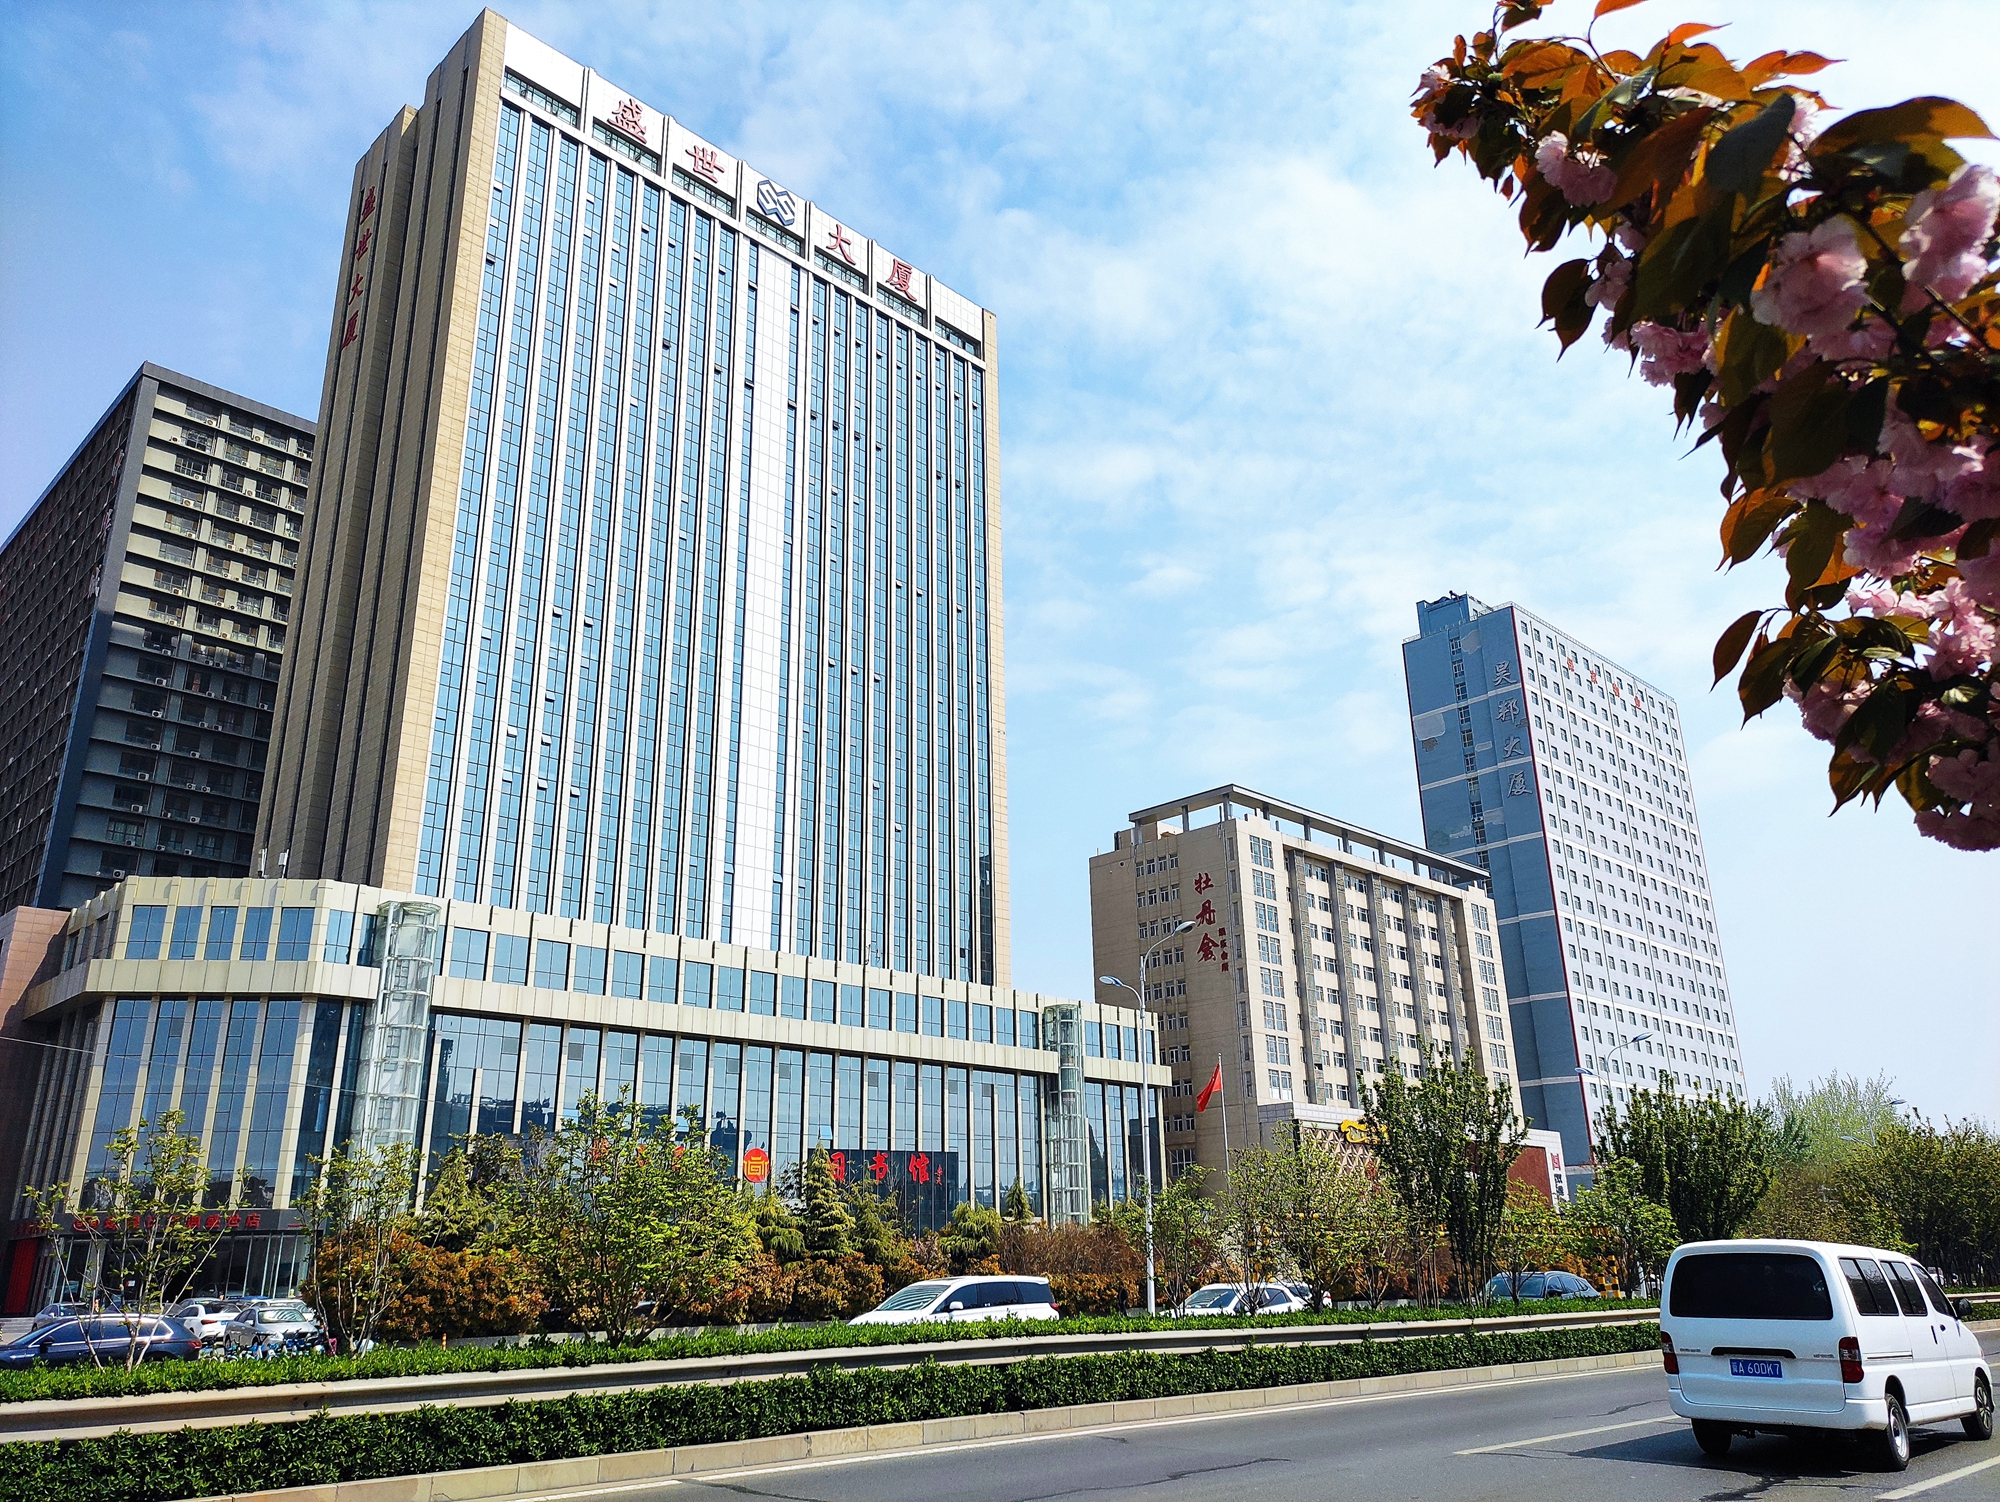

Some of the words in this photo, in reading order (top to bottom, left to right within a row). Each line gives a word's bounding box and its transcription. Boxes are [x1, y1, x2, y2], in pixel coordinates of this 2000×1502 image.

[341, 186, 376, 351] 盛世大厦
[608, 98, 917, 302] 盛世大厦
